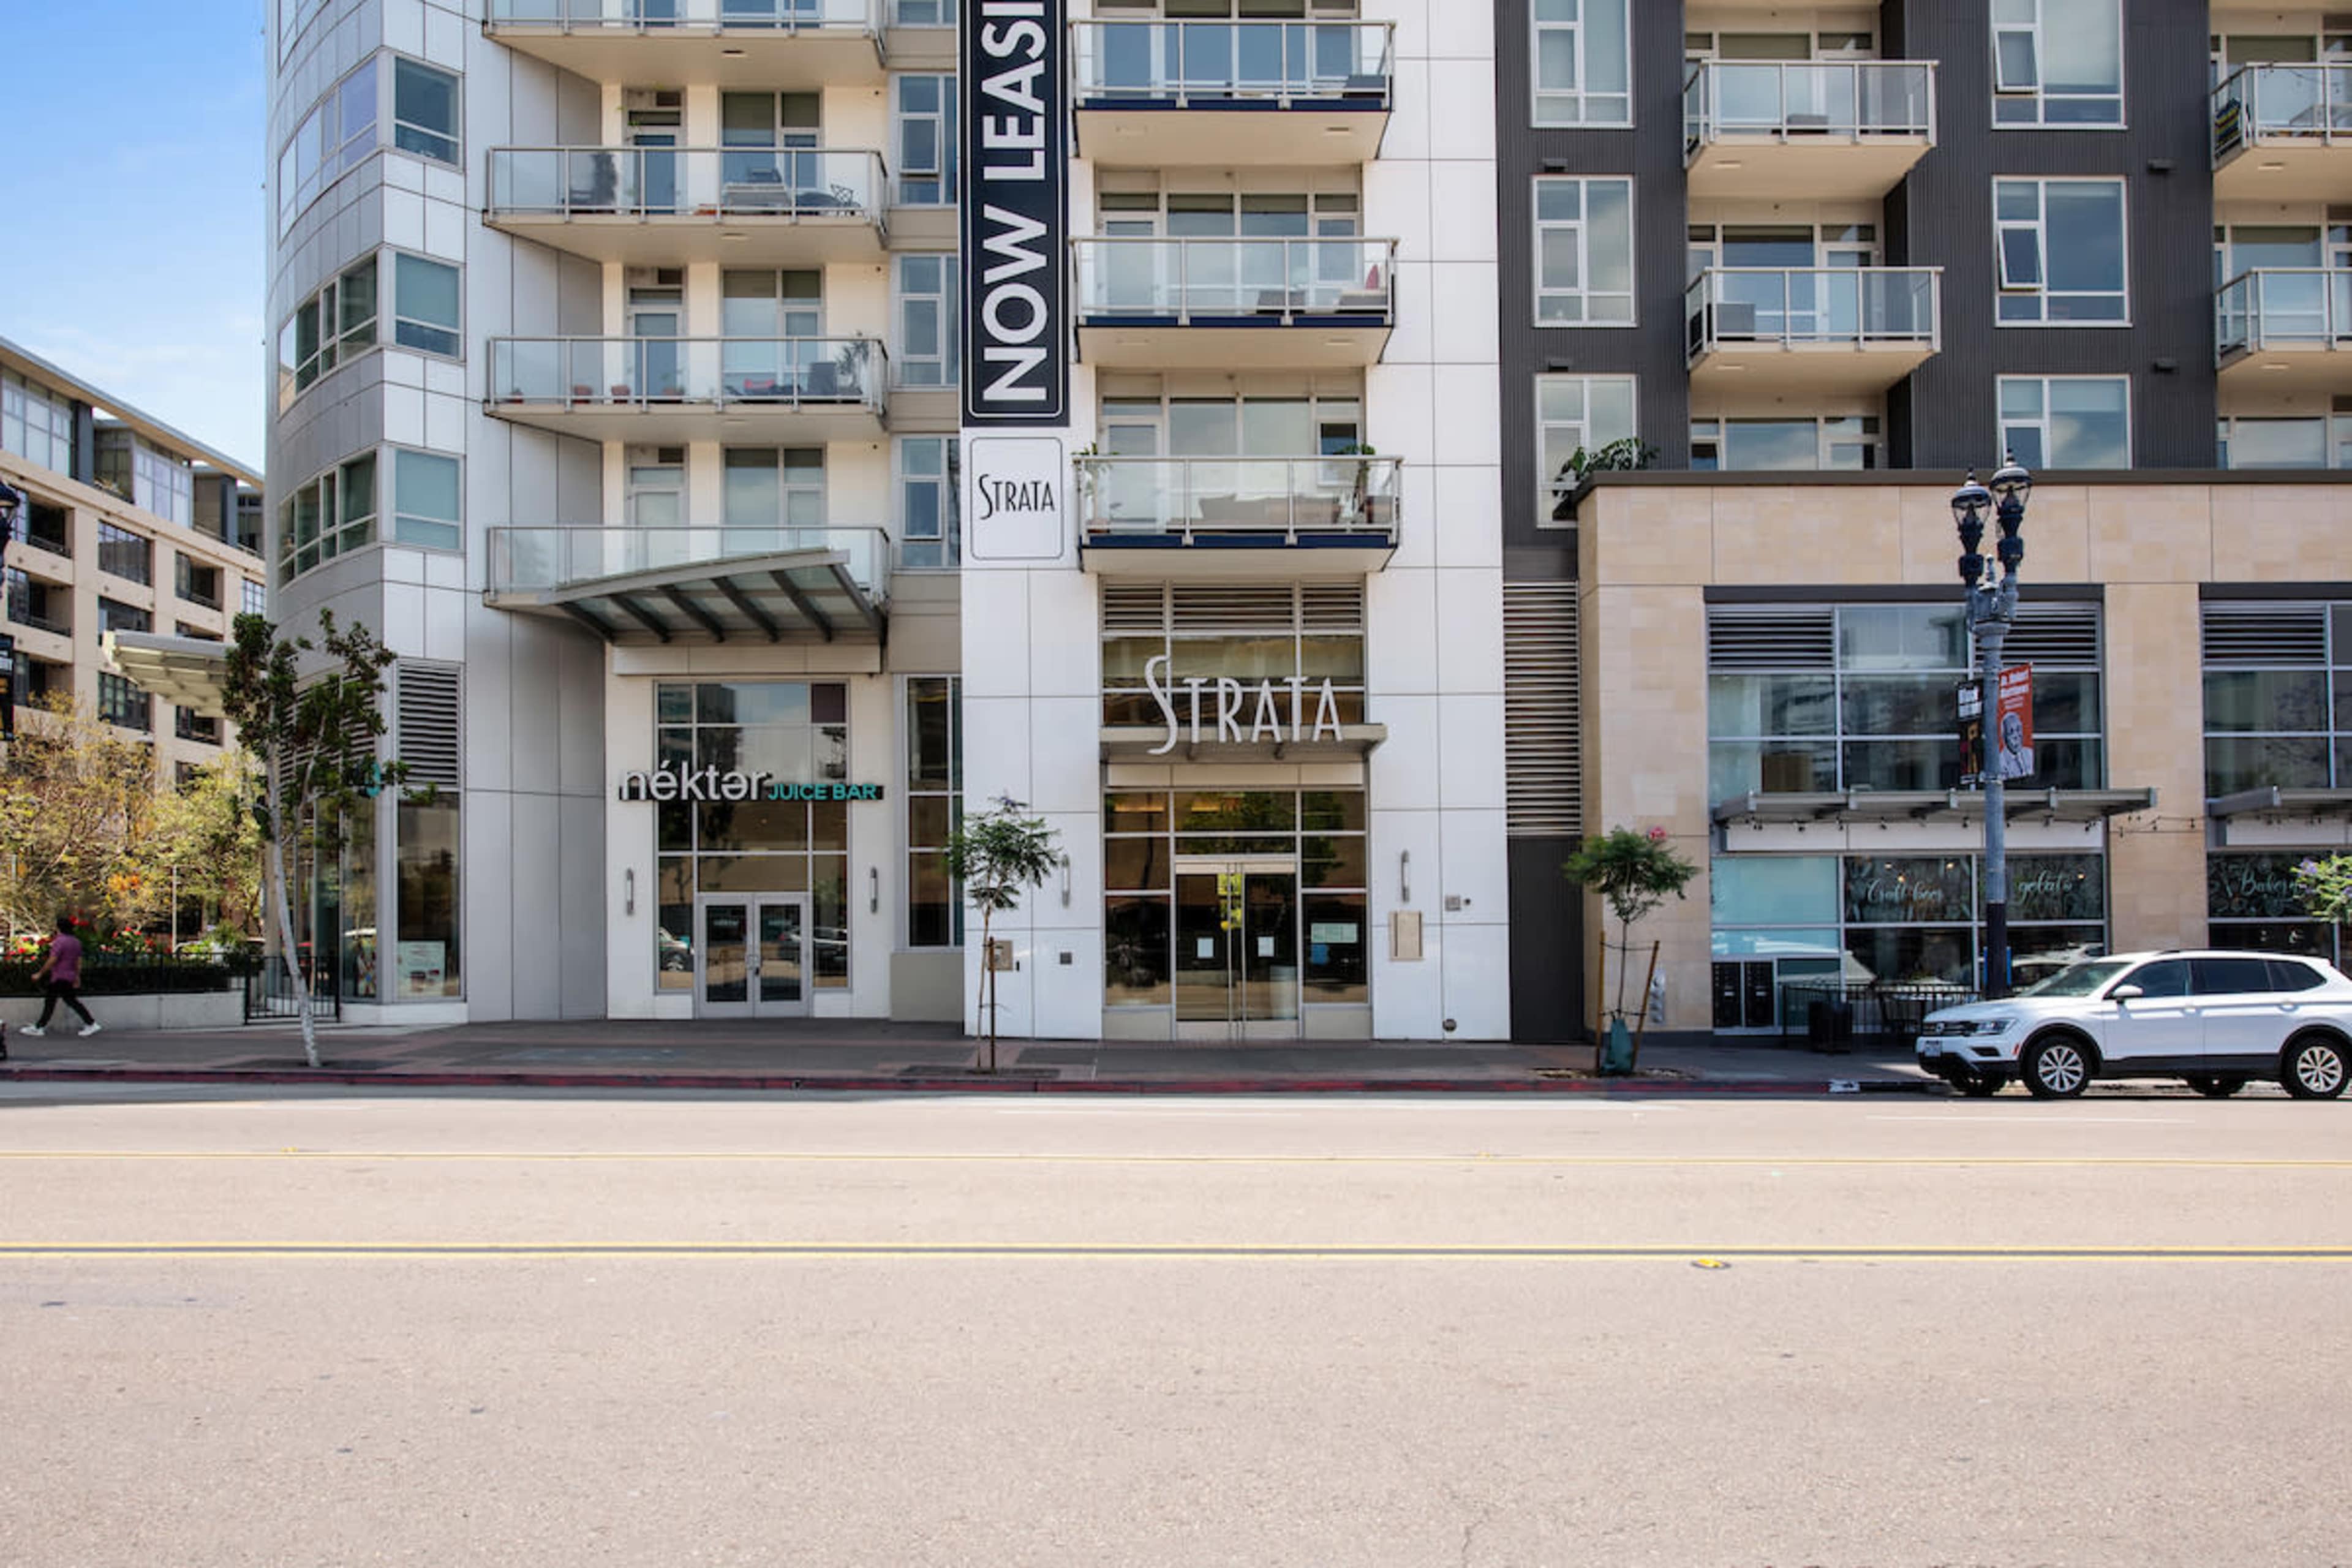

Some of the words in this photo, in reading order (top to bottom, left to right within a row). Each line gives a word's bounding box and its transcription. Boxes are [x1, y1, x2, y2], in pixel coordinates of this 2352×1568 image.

[981, 1, 1047, 180] LEASI
[981, 203, 1048, 401] NOW
[979, 473, 1055, 520] STRATA
[1145, 655, 1343, 755] STRATA
[768, 783, 829, 801] JUICE
[832, 783, 877, 801] BAR
